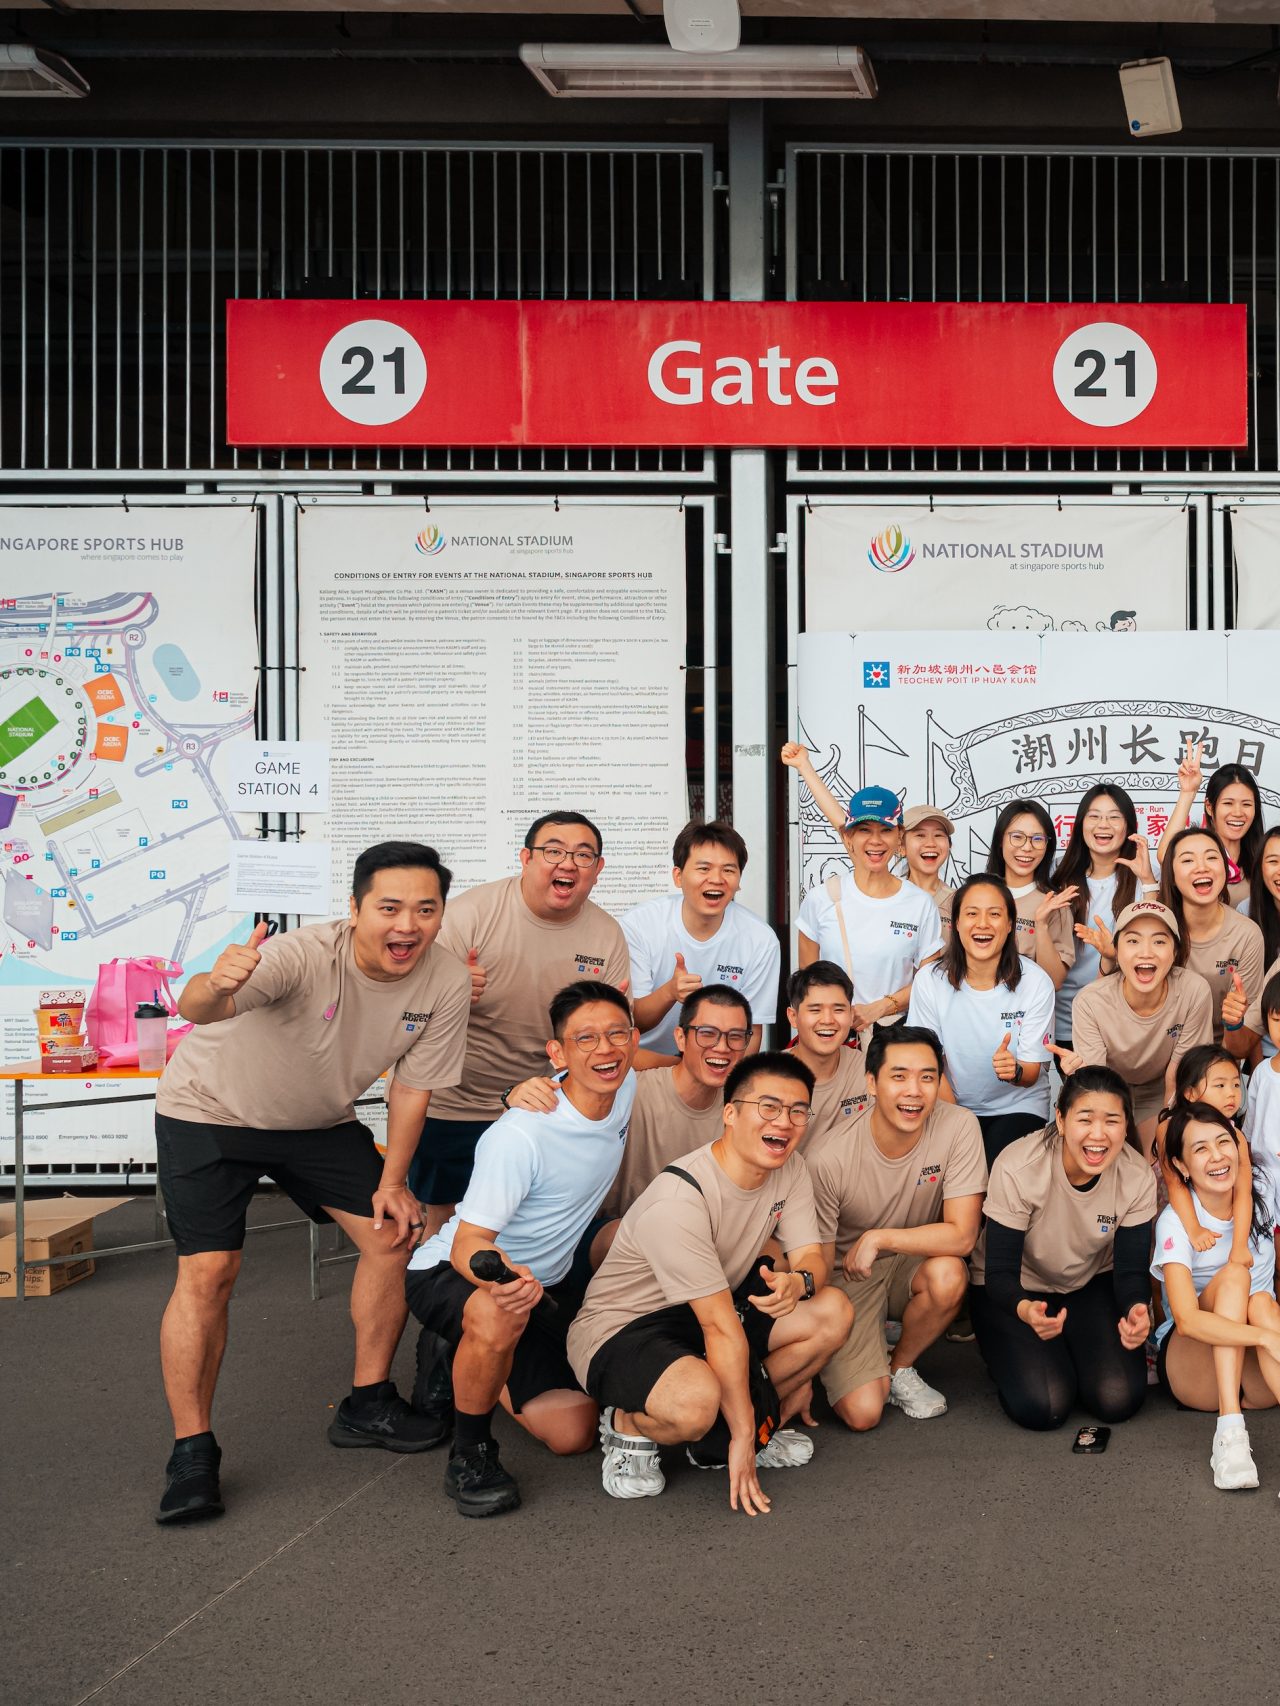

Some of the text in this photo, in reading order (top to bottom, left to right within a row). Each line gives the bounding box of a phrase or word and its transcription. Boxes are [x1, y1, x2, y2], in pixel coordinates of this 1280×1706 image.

[342, 347, 404, 394] 21
[648, 340, 839, 406] Gate
[1075, 350, 1135, 397] 21
[0, 538, 183, 551] NGAPORE SPORTS HUB
[452, 536, 572, 546] NATIONAL STADIUM
[923, 544, 1103, 558] NATIONAL STADIUM
[169, 554, 183, 562] play
[1020, 562, 1059, 572] singapore
[1062, 562, 1086, 571] sports
[129, 633, 138, 642] R2
[897, 664, 1037, 675] 新加坡潮州八邑会馆
[186, 742, 195, 751] R3
[255, 762, 300, 774] GAME
[238, 782, 318, 795] STATION 4
